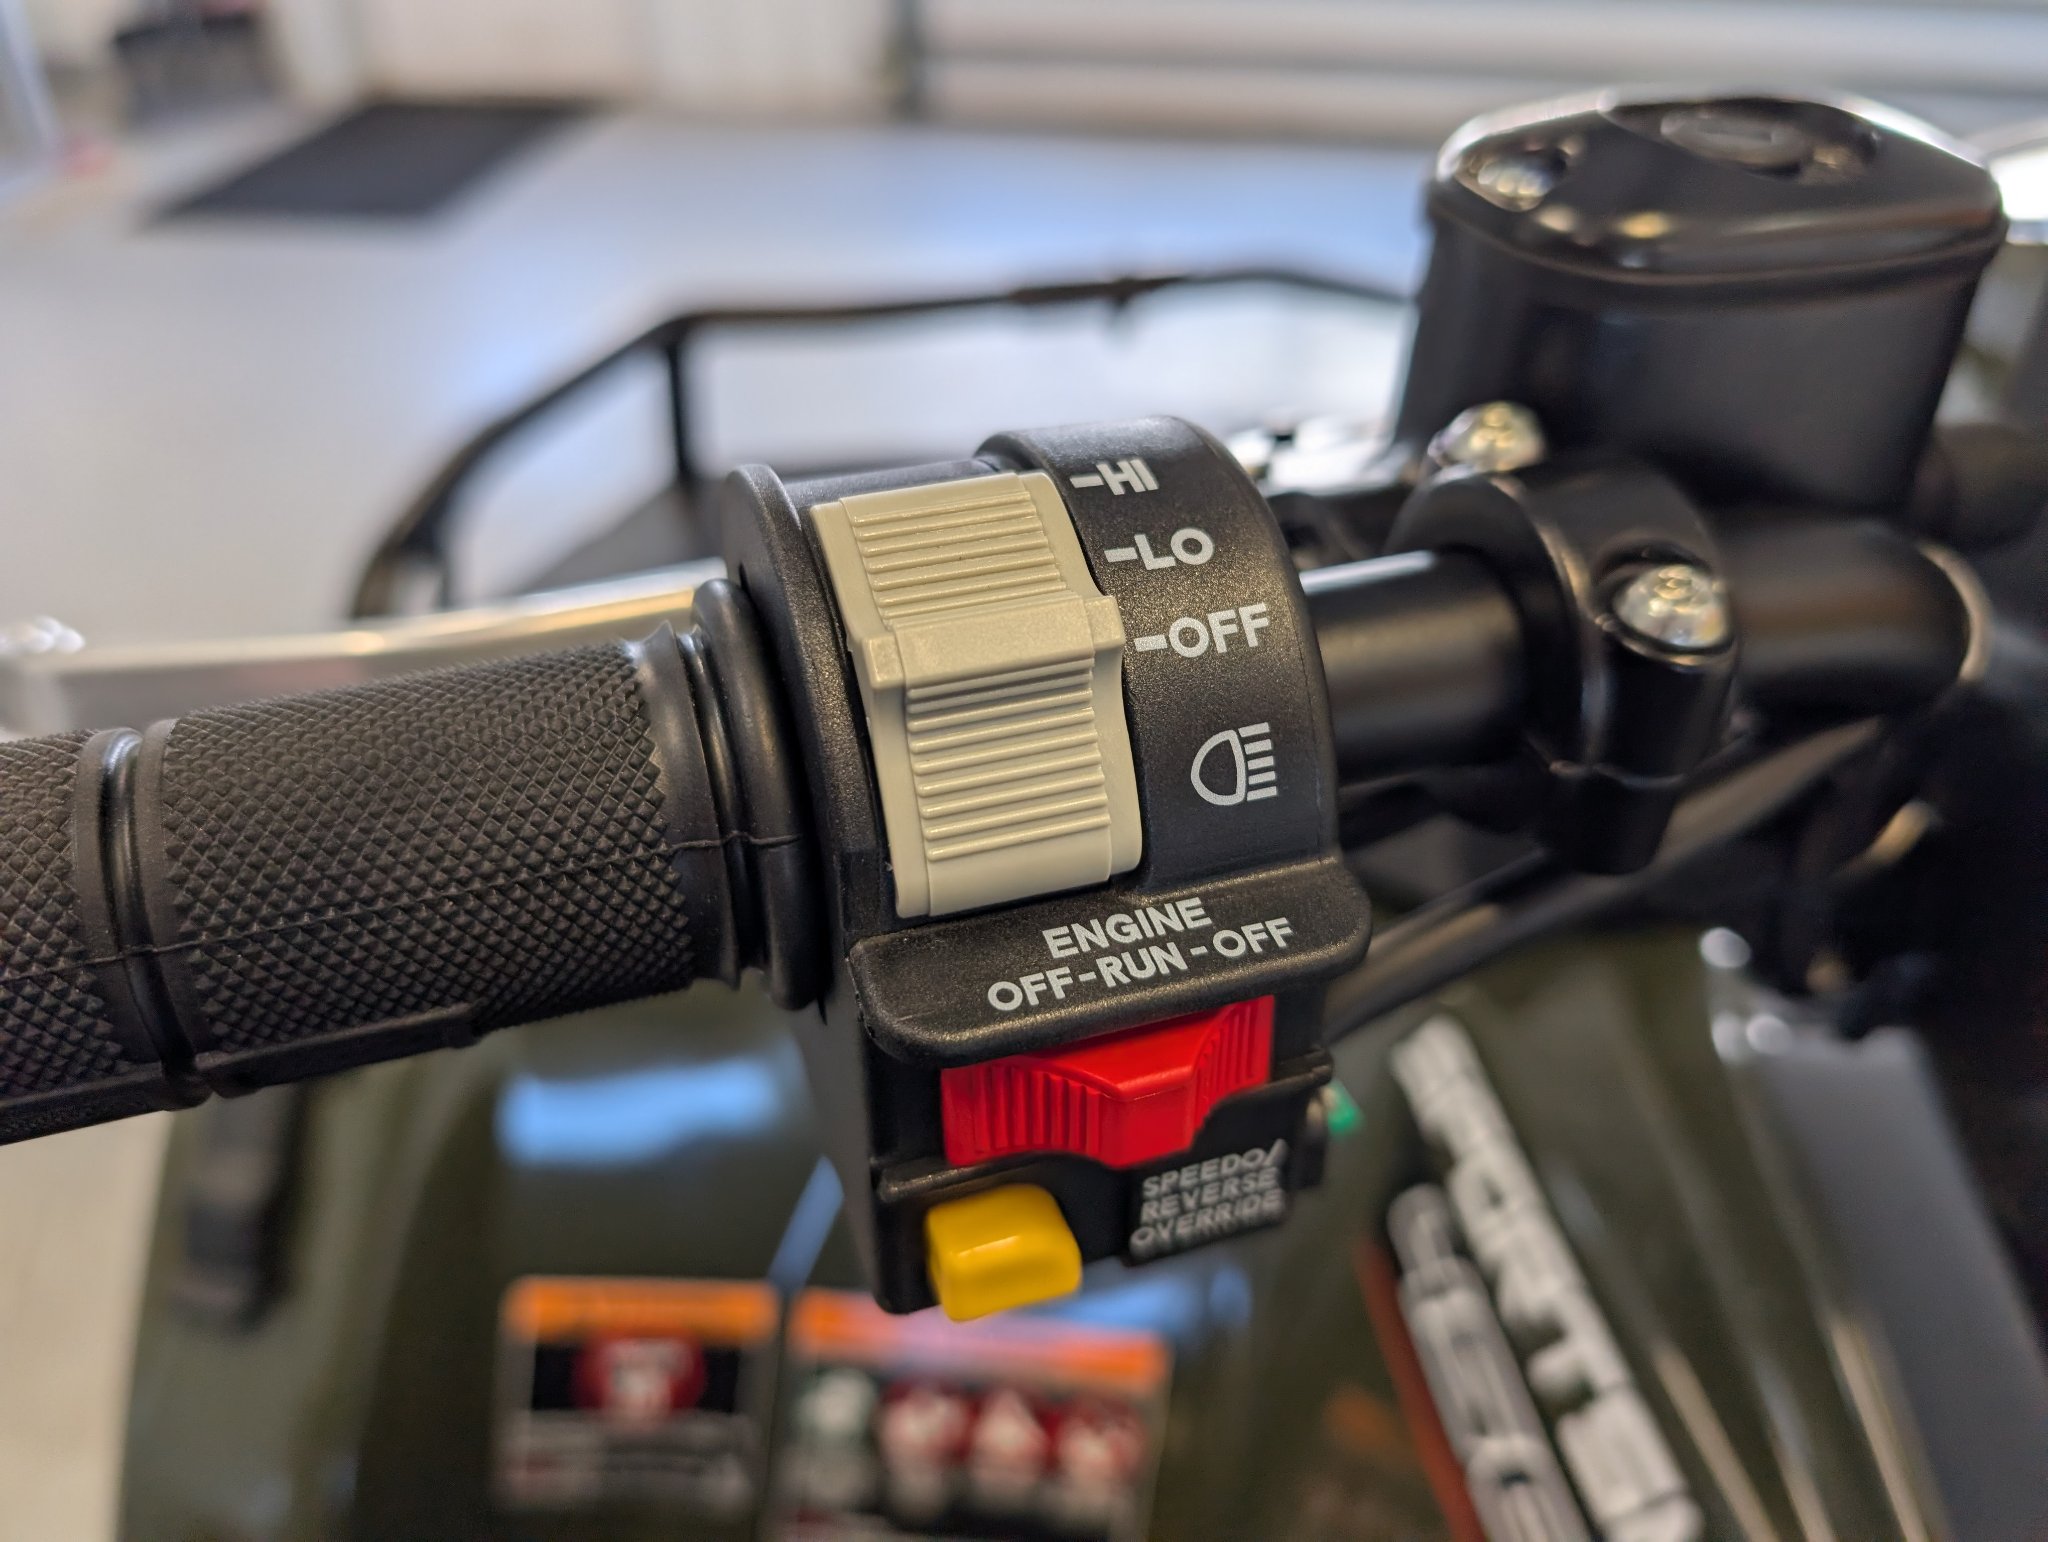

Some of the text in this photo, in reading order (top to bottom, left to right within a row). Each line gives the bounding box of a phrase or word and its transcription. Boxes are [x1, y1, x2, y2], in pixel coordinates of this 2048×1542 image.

[1042, 897, 1212, 958] ENGINE
[1141, 1167, 1279, 1225] REVERSE
[1142, 1138, 1289, 1197] SPEEDO/
[1129, 1187, 1286, 1257] OVERRIDE
